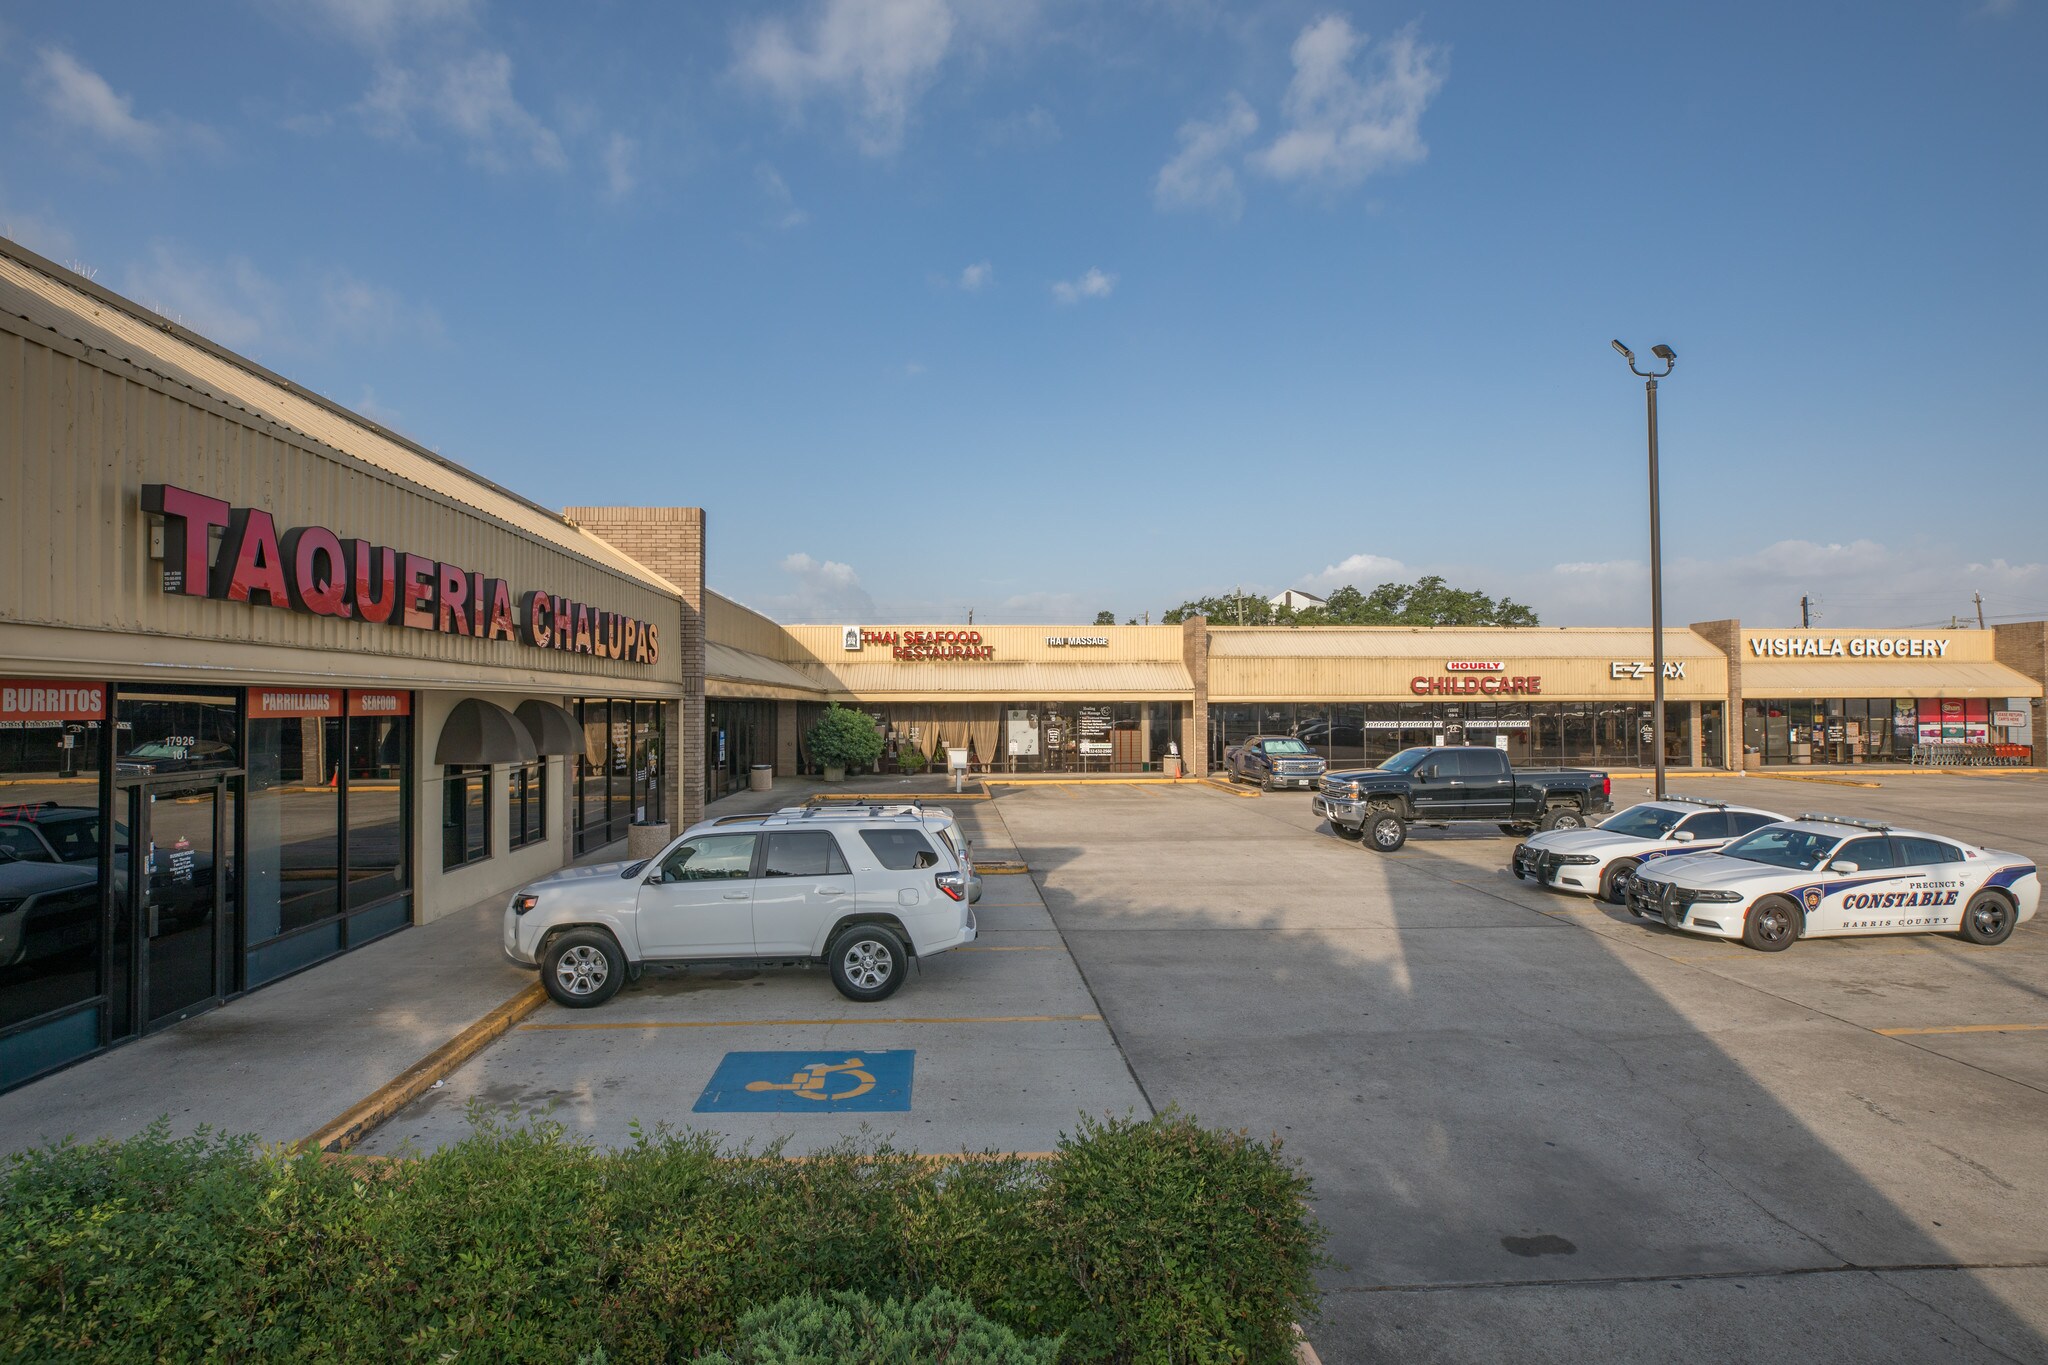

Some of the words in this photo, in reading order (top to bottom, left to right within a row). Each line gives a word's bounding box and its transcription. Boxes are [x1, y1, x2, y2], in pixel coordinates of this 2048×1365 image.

[160, 484, 516, 642] TAQUERIA
[529, 590, 660, 666] CHALUPAS
[863, 631, 898, 645] THAI
[903, 631, 982, 645] SEAFOOD
[1045, 636, 1065, 646] THAI
[1068, 637, 1108, 646] MASSAGE
[893, 645, 994, 661] RESTAURANT
[1750, 638, 1845, 656] VISHALA
[1849, 638, 1950, 656] GROCERY
[1451, 662, 1501, 670] HOURLY
[1611, 661, 1646, 678] E-Z
[1411, 676, 1542, 695] CHILDCARE
[2, 687, 102, 713] BURRITOS
[262, 693, 331, 711] PARRILLADAS
[361, 695, 397, 711] SEAFOOD
[165, 736, 195, 747] 17926
[172, 750, 189, 760] 101
[1909, 881, 1956, 889] PRECINCT
[1842, 890, 1959, 910] CONSTABLE
[1842, 919, 1892, 928] HARRIS
[1898, 917, 1949, 926] COUNTY
